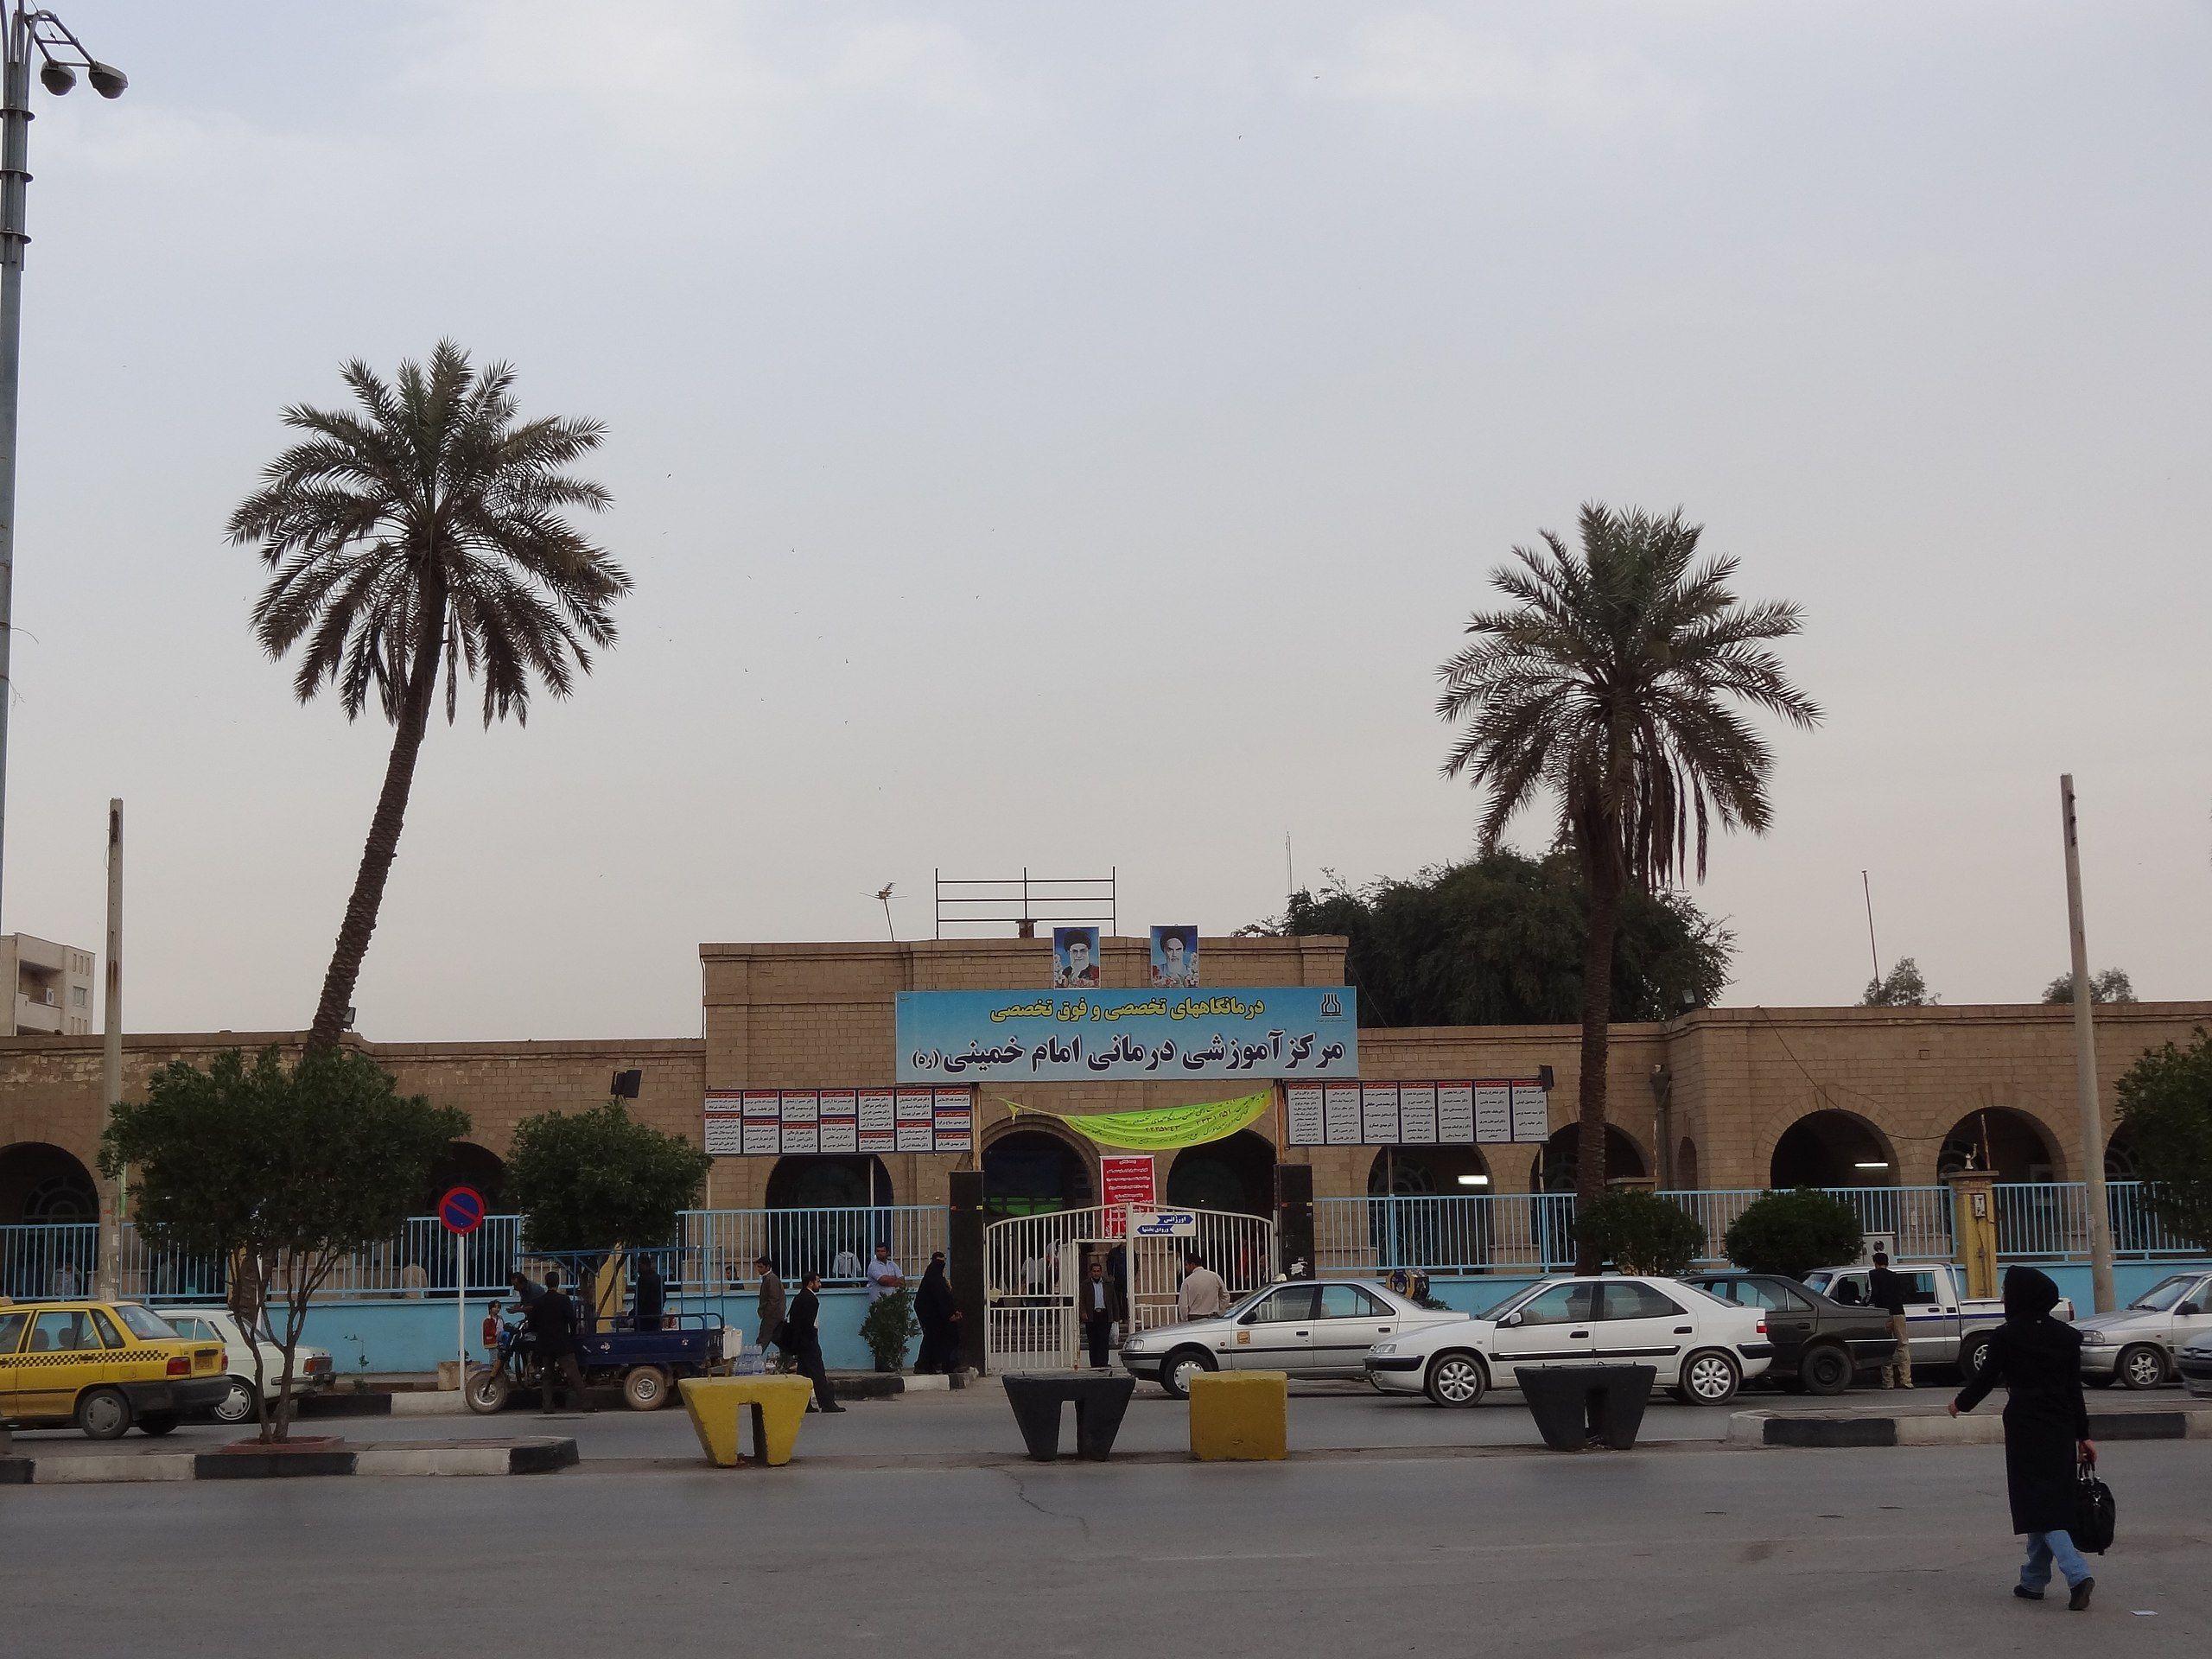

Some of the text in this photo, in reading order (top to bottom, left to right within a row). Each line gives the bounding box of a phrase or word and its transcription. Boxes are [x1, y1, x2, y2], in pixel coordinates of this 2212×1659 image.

[990, 996, 1265, 1022] درمانگاههای تخصصی و فوق تخصصی
[912, 1028, 1344, 1073] مرکز آموزشی درمانی امام خمینی (ره)
[1163, 1214, 1186, 1224] اورژانس
